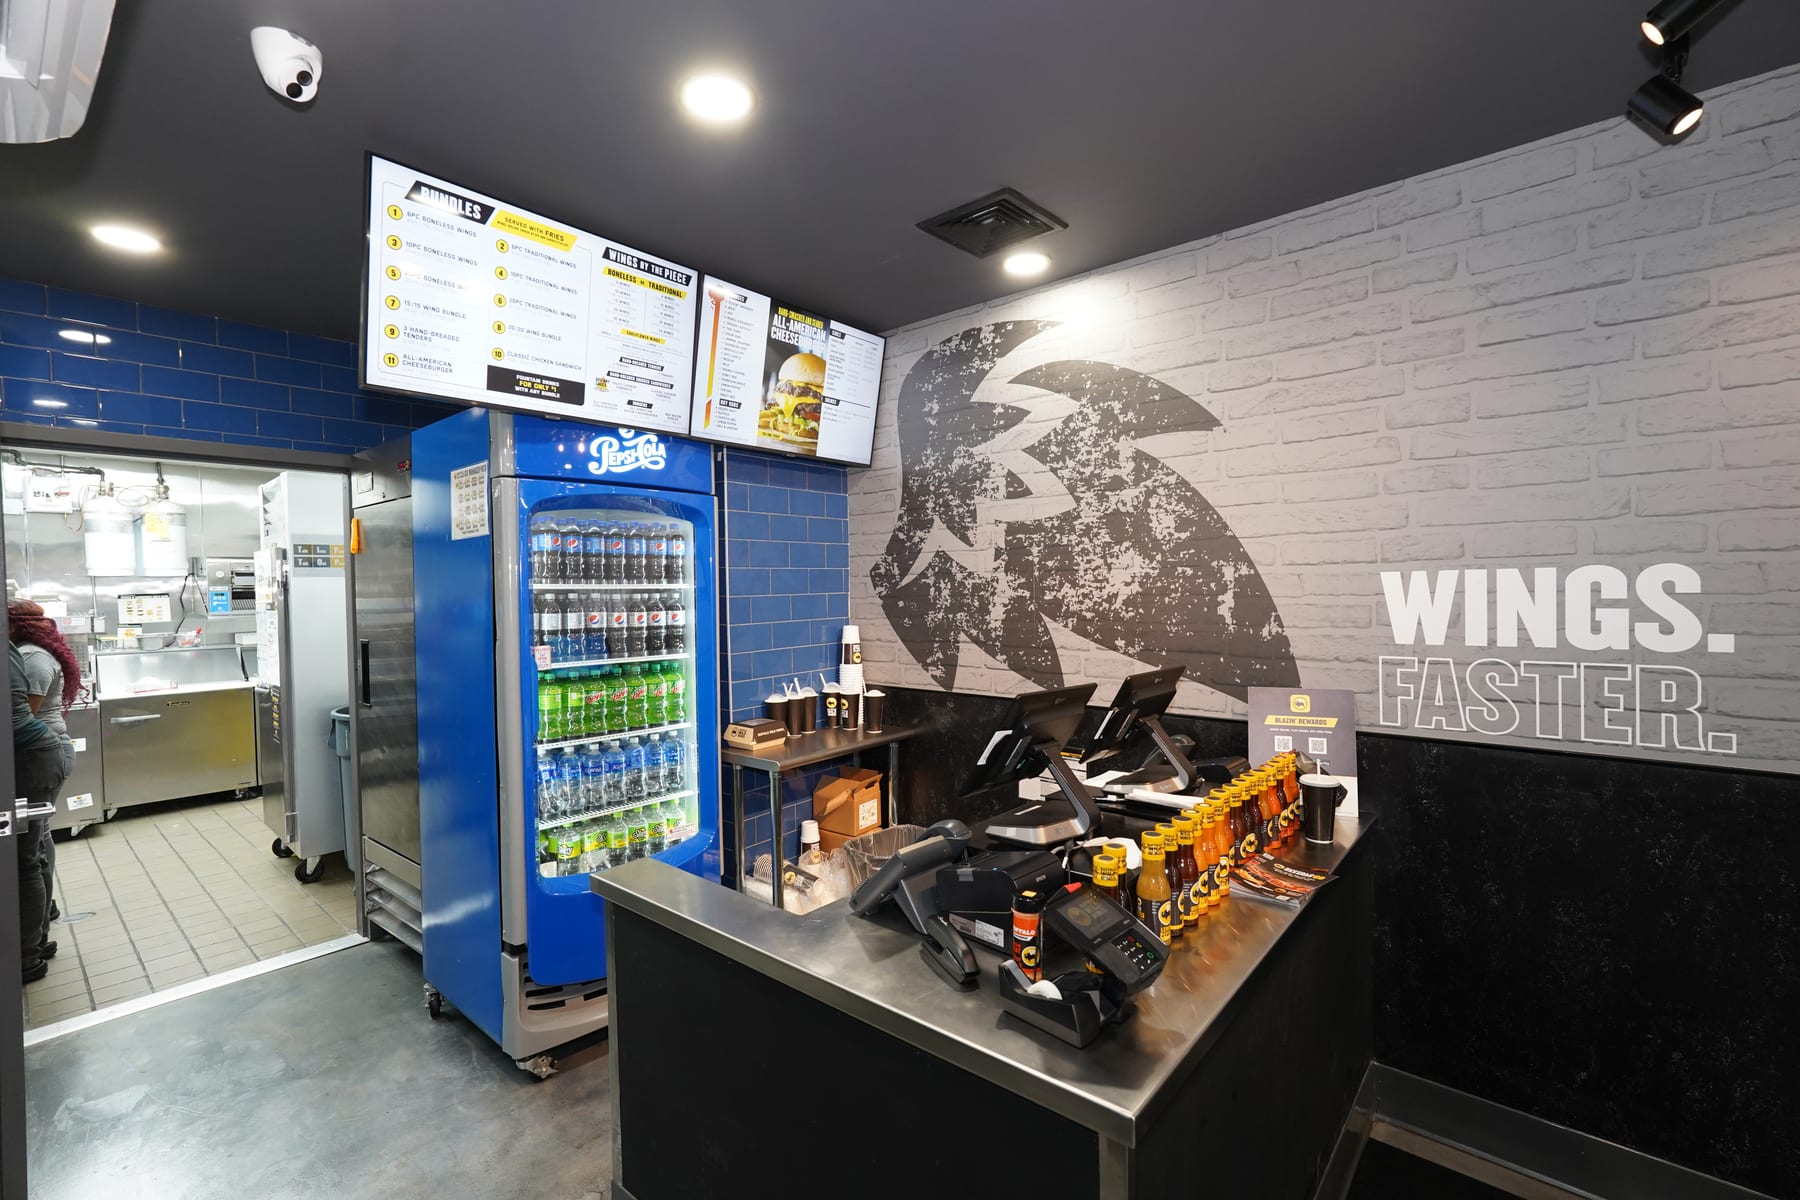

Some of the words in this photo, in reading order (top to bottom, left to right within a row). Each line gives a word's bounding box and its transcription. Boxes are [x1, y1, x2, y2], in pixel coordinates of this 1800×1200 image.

[422, 215, 455, 231] BONELESS
[456, 226, 478, 238] WINGS
[504, 216, 528, 229] SERVED
[528, 224, 544, 235] WITH
[544, 229, 565, 242] FRIES
[405, 240, 422, 251] 10PC
[423, 246, 457, 261] BONELESS
[457, 255, 479, 267] WINGS
[524, 247, 560, 264] TRADITIONAL
[559, 259, 577, 270] WINGS
[608, 248, 639, 269] WINGS
[639, 260, 651, 272] BY
[650, 264, 664, 277] THE
[663, 268, 688, 285] PIECE
[422, 275, 457, 290] BONELESS
[524, 275, 560, 290] TRADITIONAL
[560, 285, 578, 295] WINGS
[607, 268, 638, 284] BONELESS
[648, 282, 683, 299] TRADITIONAL
[403, 299, 422, 309] 15/15
[422, 303, 441, 314] WING
[441, 308, 468, 320] BUNDLE
[524, 301, 560, 316] TRADITIONAL
[560, 310, 577, 320] WINGS
[402, 331, 433, 344] TENDERS
[408, 326, 461, 343] HAND-BREADED
[541, 332, 562, 342] BUNDLE
[401, 359, 454, 375] CHEESEBURGER
[402, 353, 453, 369] ALL-AMERICAN
[506, 350, 531, 361] CLASSIC
[531, 355, 555, 366] CHICKEN
[554, 360, 583, 372] SANDWICH
[519, 380, 532, 389] FOR
[533, 383, 550, 392] ONLY
[1379, 562, 1735, 653] WINGS.
[1378, 655, 1737, 754] FASTER.
[1298, 717, 1328, 726] REWARDS
